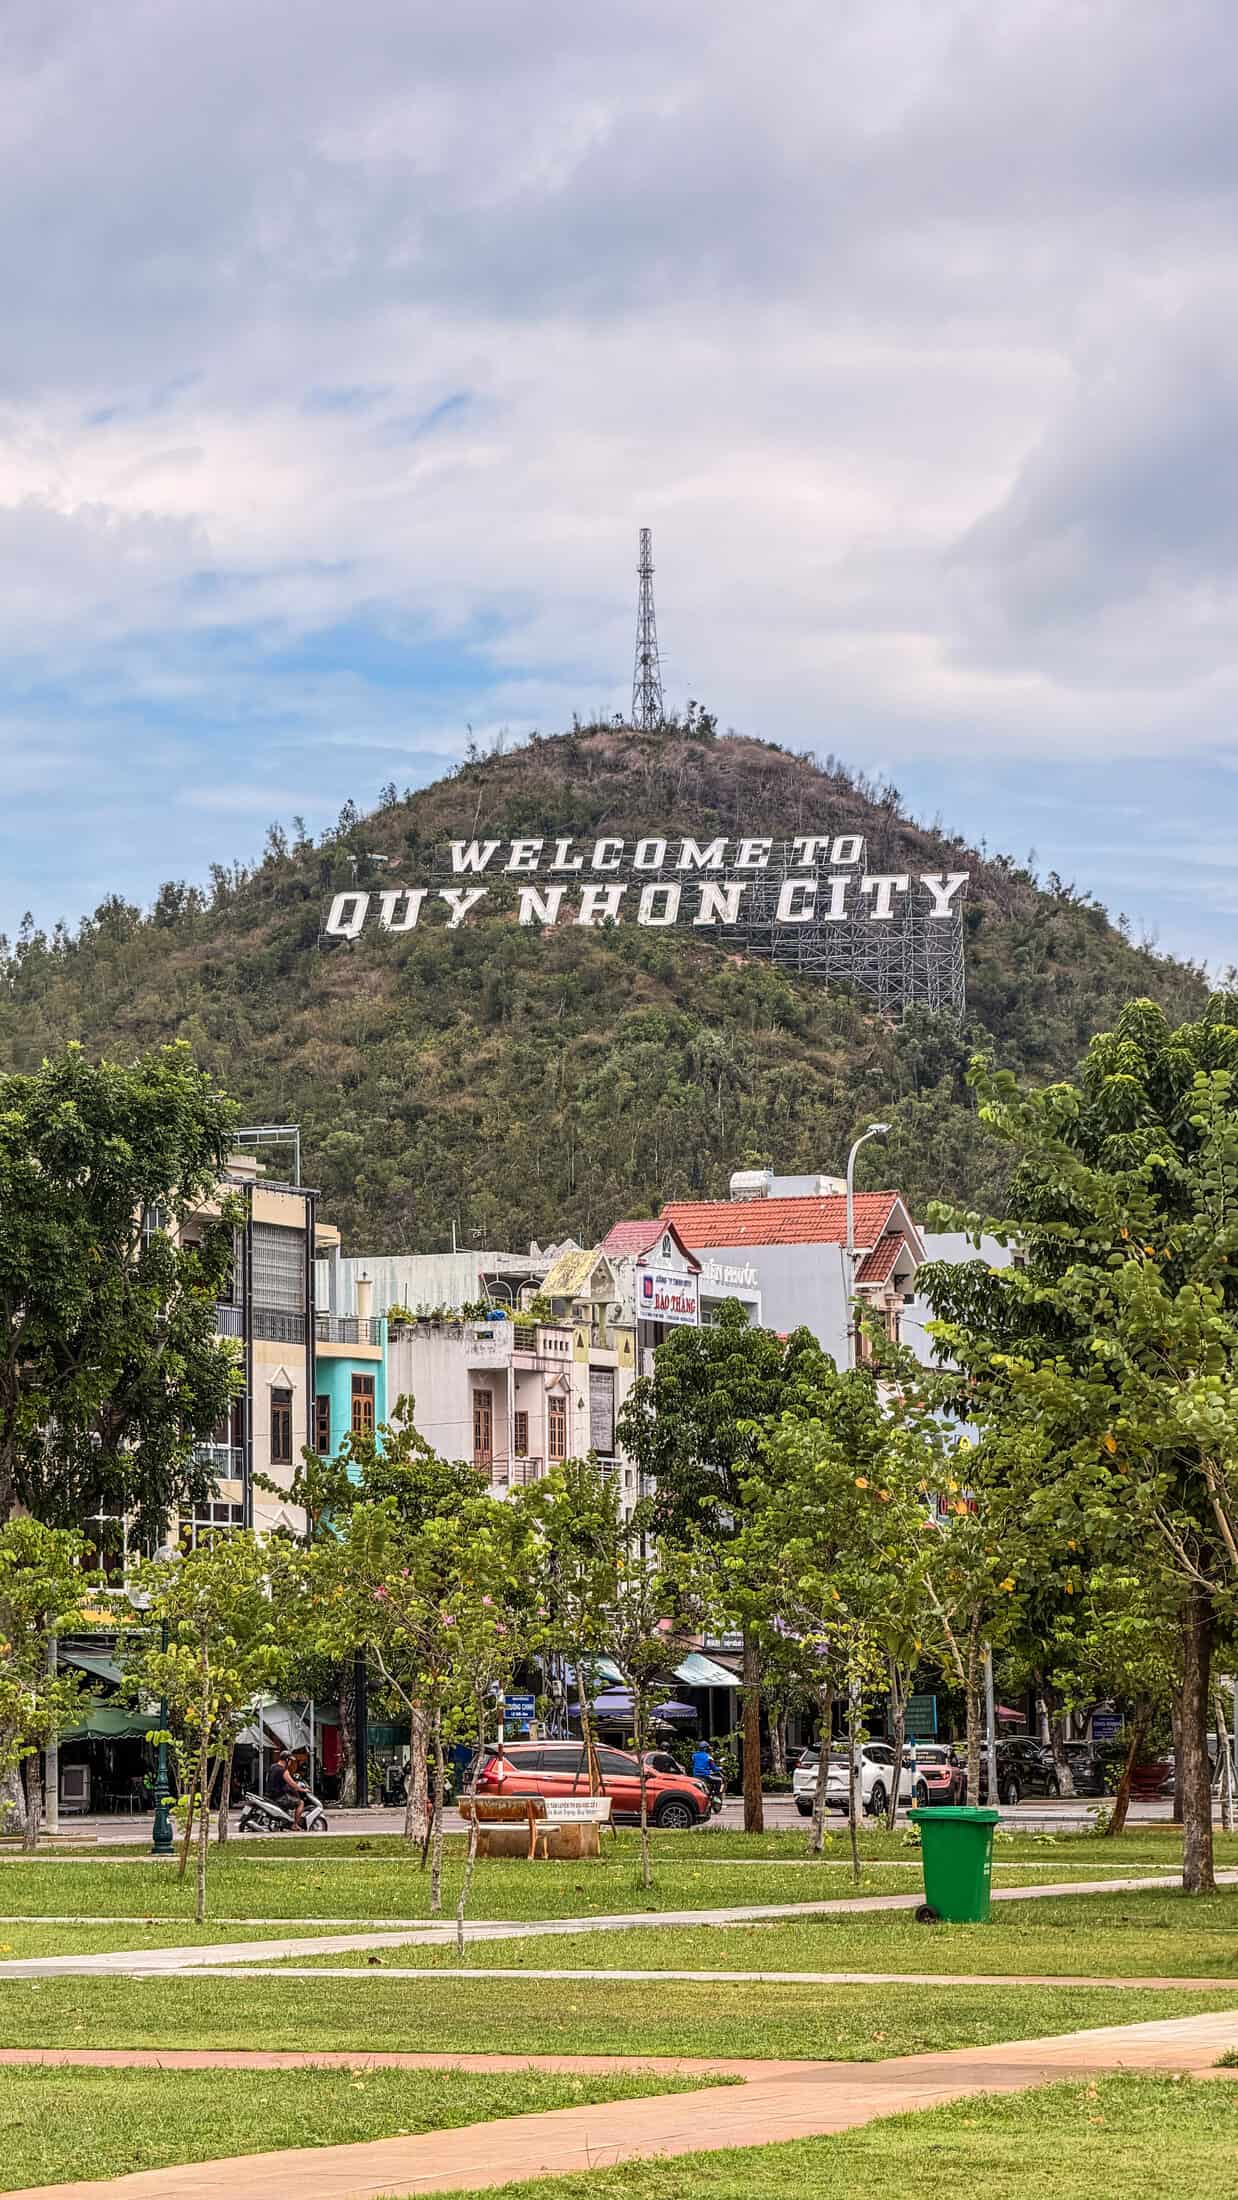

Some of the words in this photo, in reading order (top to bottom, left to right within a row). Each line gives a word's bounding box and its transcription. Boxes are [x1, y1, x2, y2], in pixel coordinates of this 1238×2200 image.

[448, 836, 773, 873] WELCOME
[794, 834, 865, 866] TO
[326, 887, 490, 939] QUY
[517, 882, 746, 926] NHON
[775, 872, 969, 923] CITY
